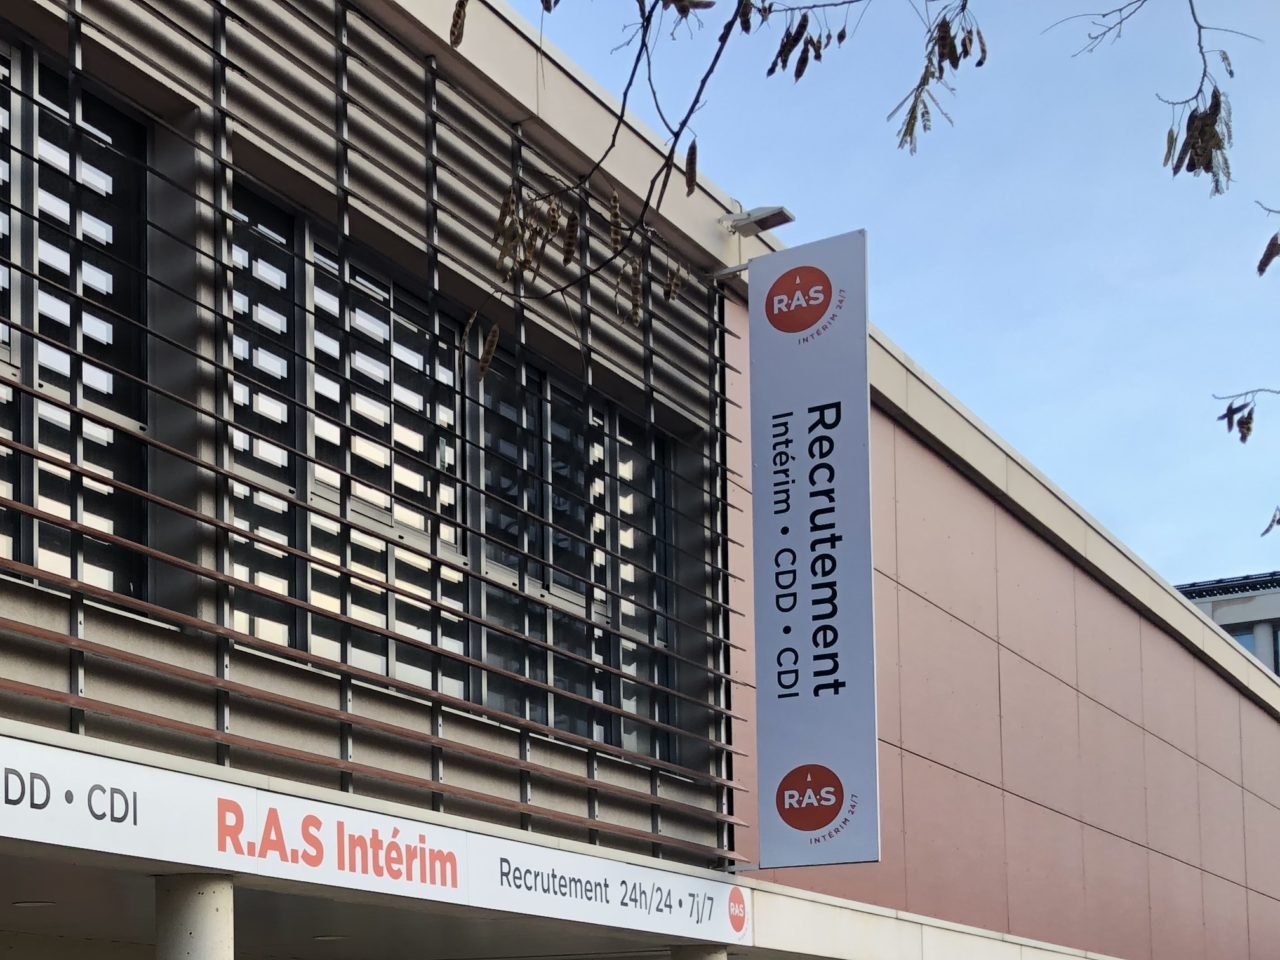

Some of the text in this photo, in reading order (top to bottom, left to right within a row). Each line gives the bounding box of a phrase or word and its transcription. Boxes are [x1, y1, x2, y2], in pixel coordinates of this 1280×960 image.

[797, 288, 846, 345] INTÉRIM 24/7
[772, 411, 800, 699] Intérim CDD CDI
[807, 401, 846, 697] Recrutement
[86, 783, 138, 826] CDI
[809, 793, 859, 846] INTÉRIM 24/7
[216, 797, 458, 889] R.A.S Intérim
[499, 857, 714, 924] Recrutement 24h/24 7j/7
